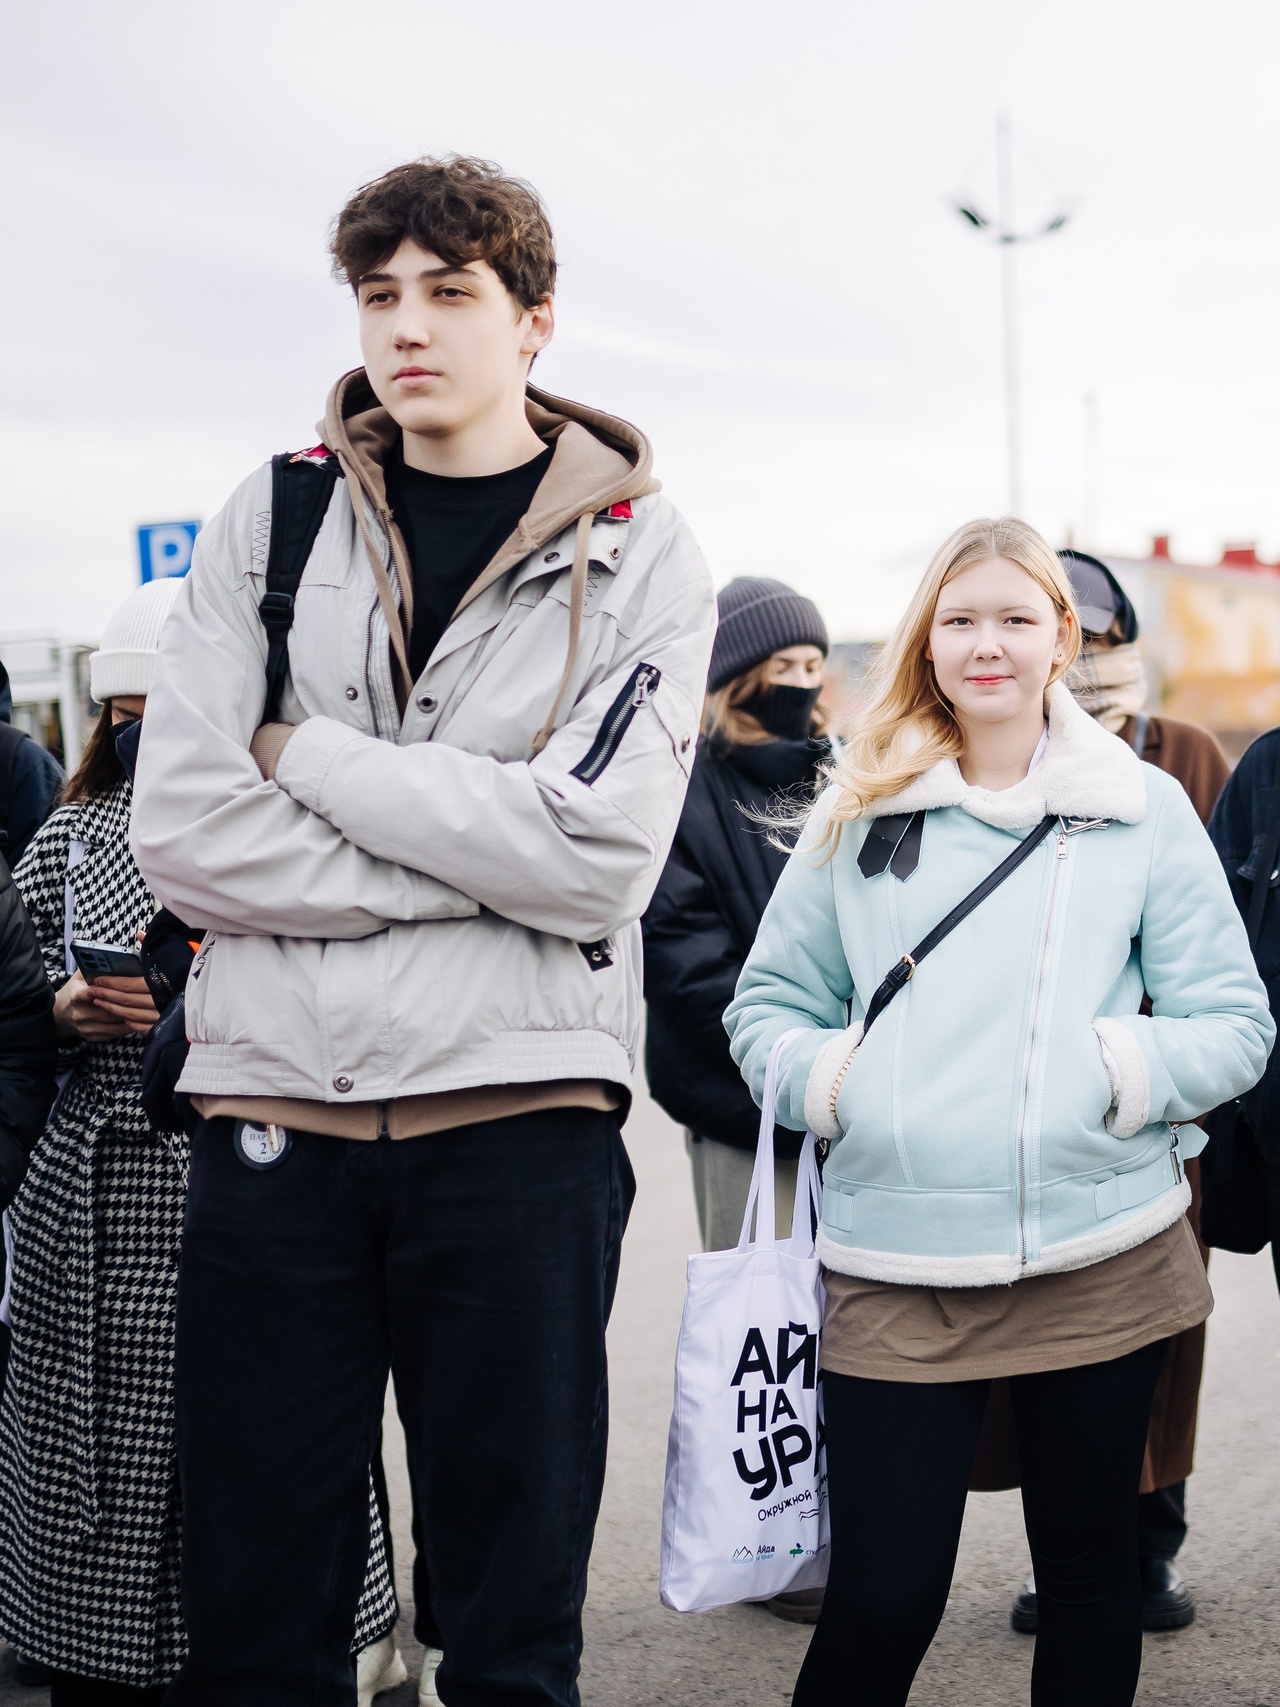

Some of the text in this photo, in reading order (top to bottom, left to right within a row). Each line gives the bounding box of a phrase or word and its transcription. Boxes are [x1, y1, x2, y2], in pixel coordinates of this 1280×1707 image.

[149, 527, 192, 580] P
[260, 1142, 267, 1155] 2
[730, 1321, 822, 1390] АЙ
[737, 1388, 798, 1433] НА
[758, 1490, 812, 1522] Окружной
